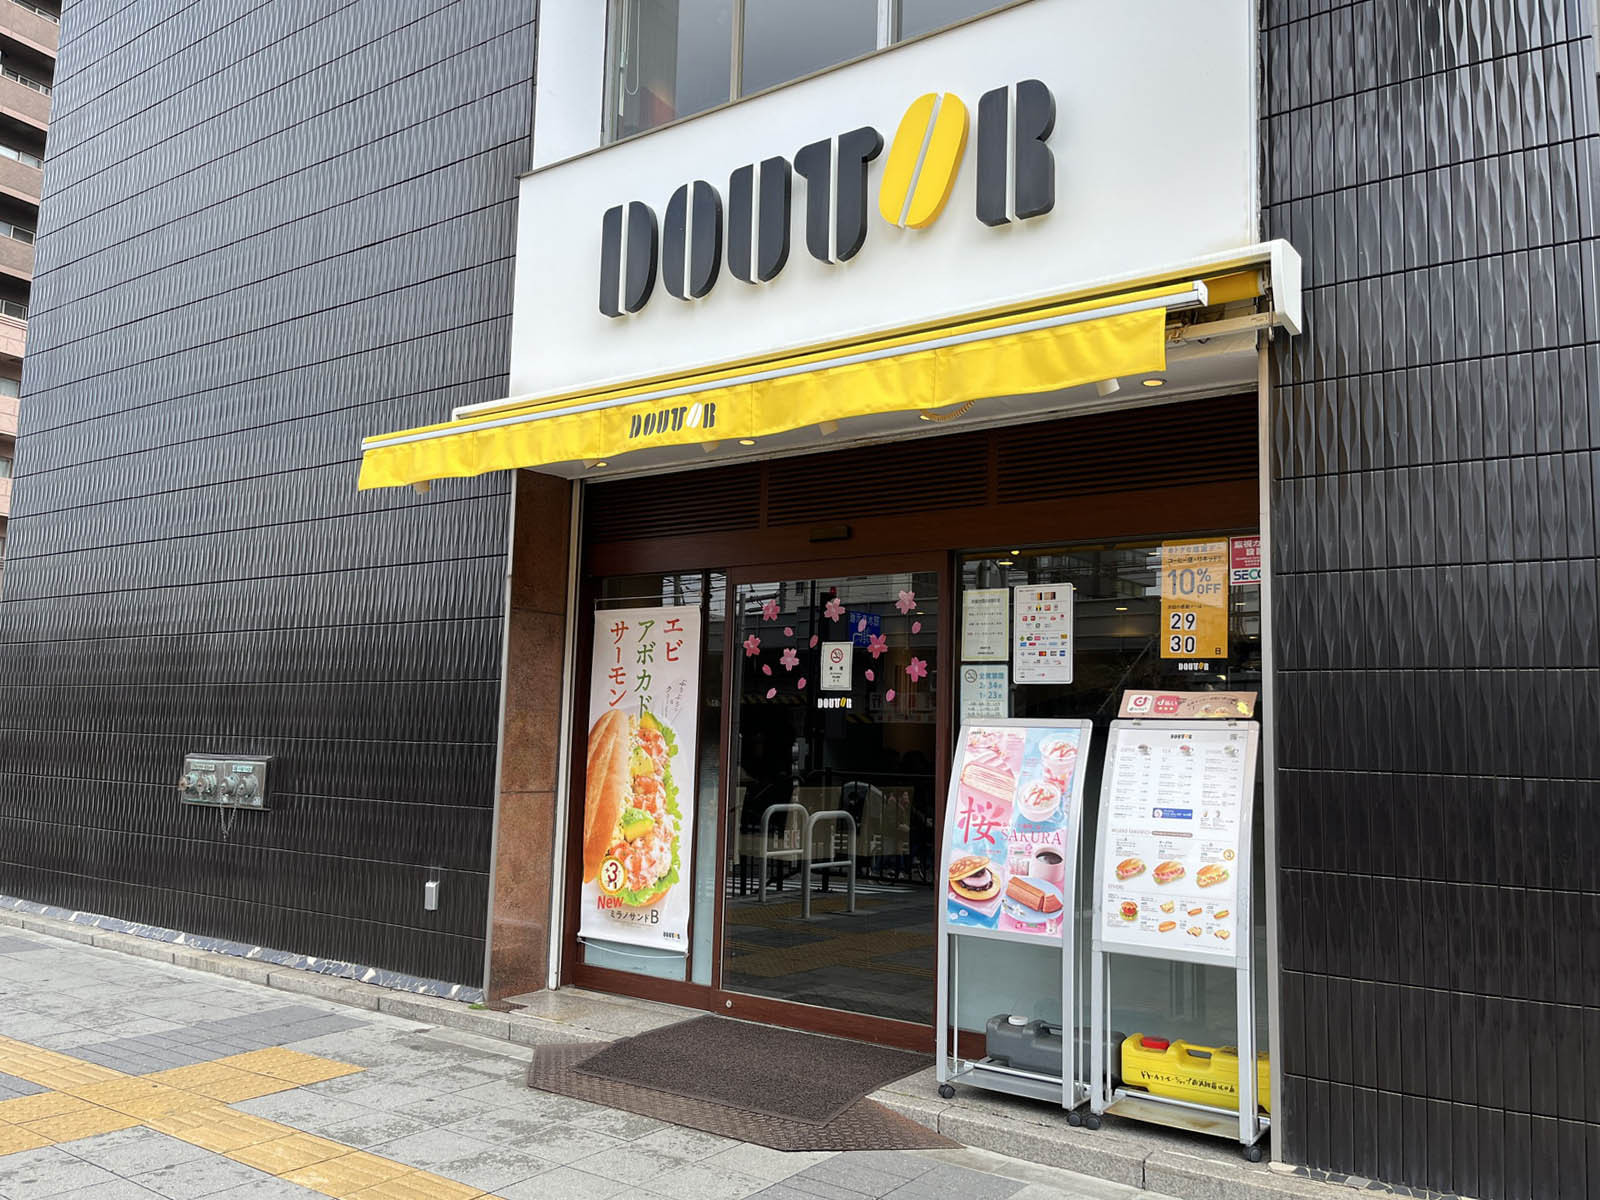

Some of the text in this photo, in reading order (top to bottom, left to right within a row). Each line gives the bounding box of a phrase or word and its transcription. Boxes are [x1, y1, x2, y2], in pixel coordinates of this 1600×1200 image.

[599, 79, 1056, 318] DOUTOR
[629, 402, 716, 438] DOUTOR
[1168, 568, 1221, 595] 10% OFF
[1171, 613, 1196, 630] 29
[663, 618, 684, 662] エビ
[1171, 635, 1196, 653] 30
[608, 620, 630, 707] サーモン
[634, 619, 656, 719] アボカド
[1178, 662, 1209, 671] DOUTOR
[817, 697, 852, 709] DOUTOR
[957, 796, 1005, 845] 桜
[1000, 828, 1062, 845] SAKURA
[597, 895, 624, 910] New
[610, 909, 660, 924] ミラノサンドB
